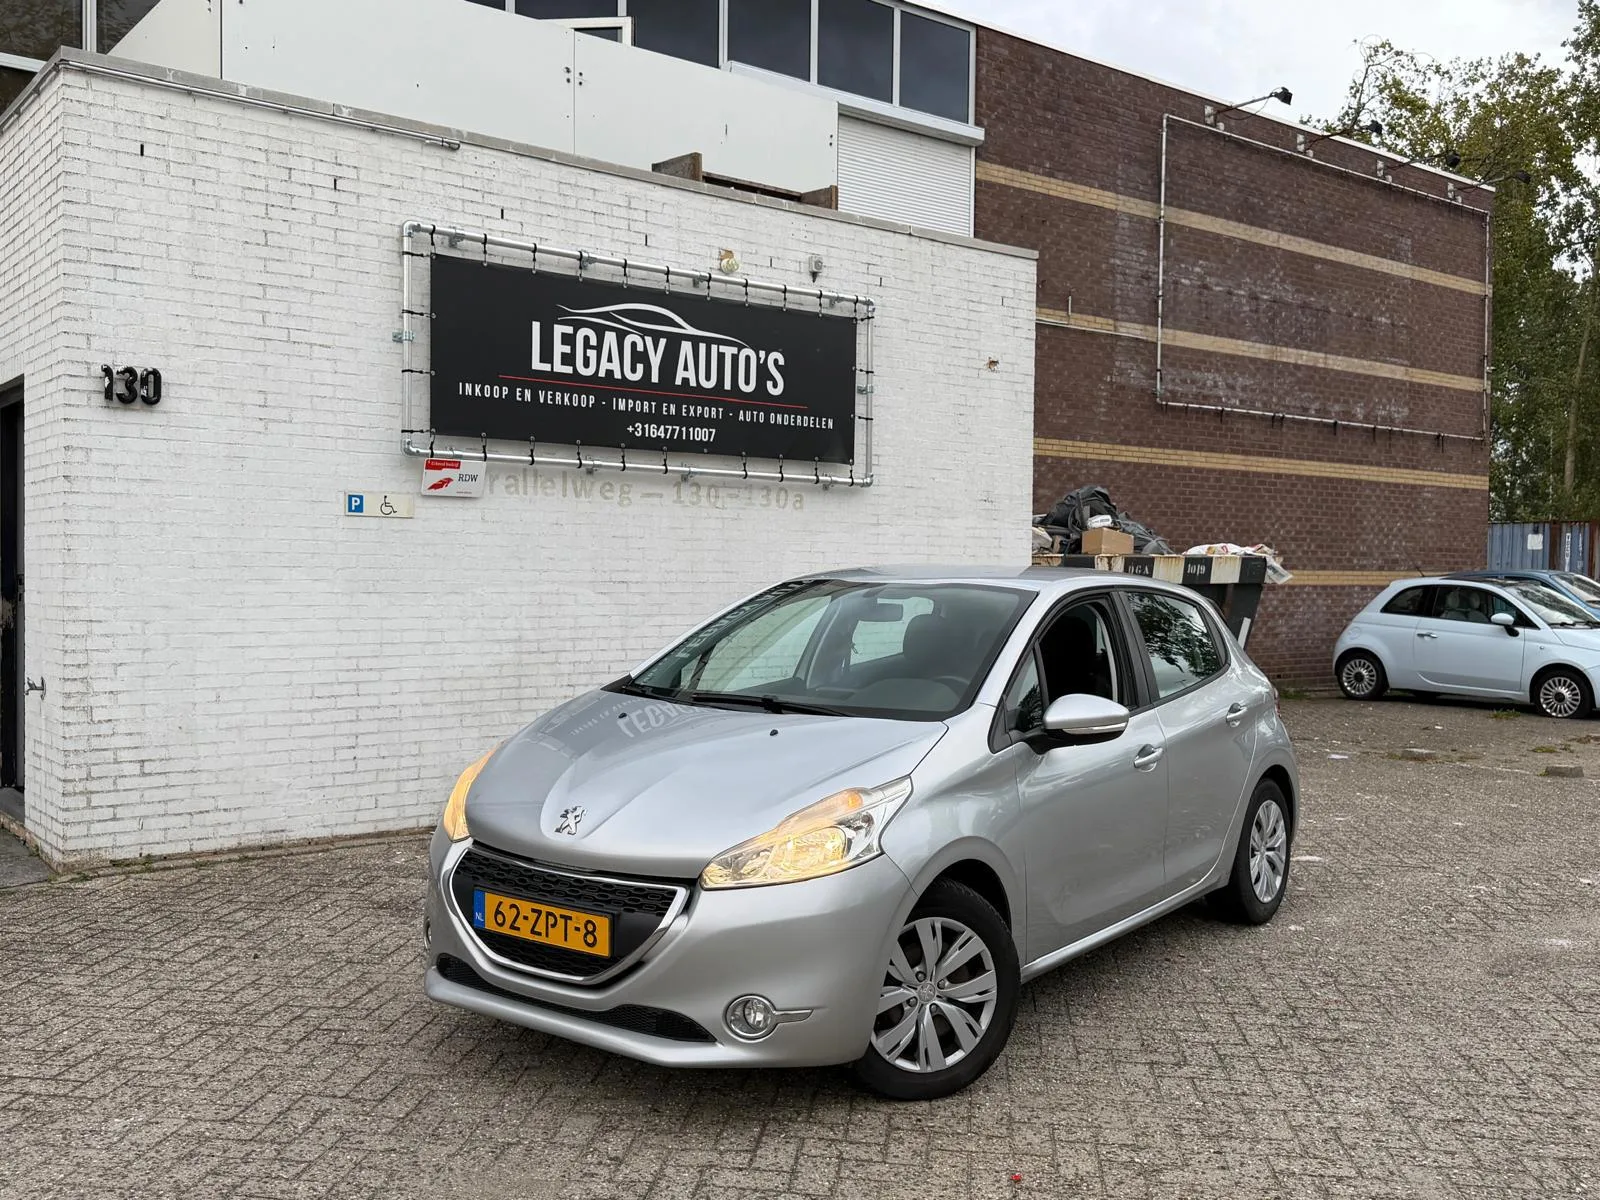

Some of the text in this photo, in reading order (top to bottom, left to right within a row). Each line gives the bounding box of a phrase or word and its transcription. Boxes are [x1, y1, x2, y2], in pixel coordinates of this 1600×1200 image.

[531, 321, 785, 396] LEGACY AUTO'S
[101, 364, 162, 405] 130
[458, 382, 509, 399] INKOOP
[516, 388, 532, 402] EN
[538, 390, 596, 408] VERKOOP
[612, 397, 657, 415] IMPORT
[662, 403, 676, 417] EN
[682, 405, 724, 420] EXPORT
[738, 410, 764, 423] AUTO
[770, 413, 834, 430] ONDERDELEN
[626, 423, 716, 442] +31647711007
[458, 473, 479, 482] RDW
[488, 468, 633, 507] rallelweg
[351, 496, 361, 511] P
[475, 901, 598, 948] NL 62-ZPT-8
